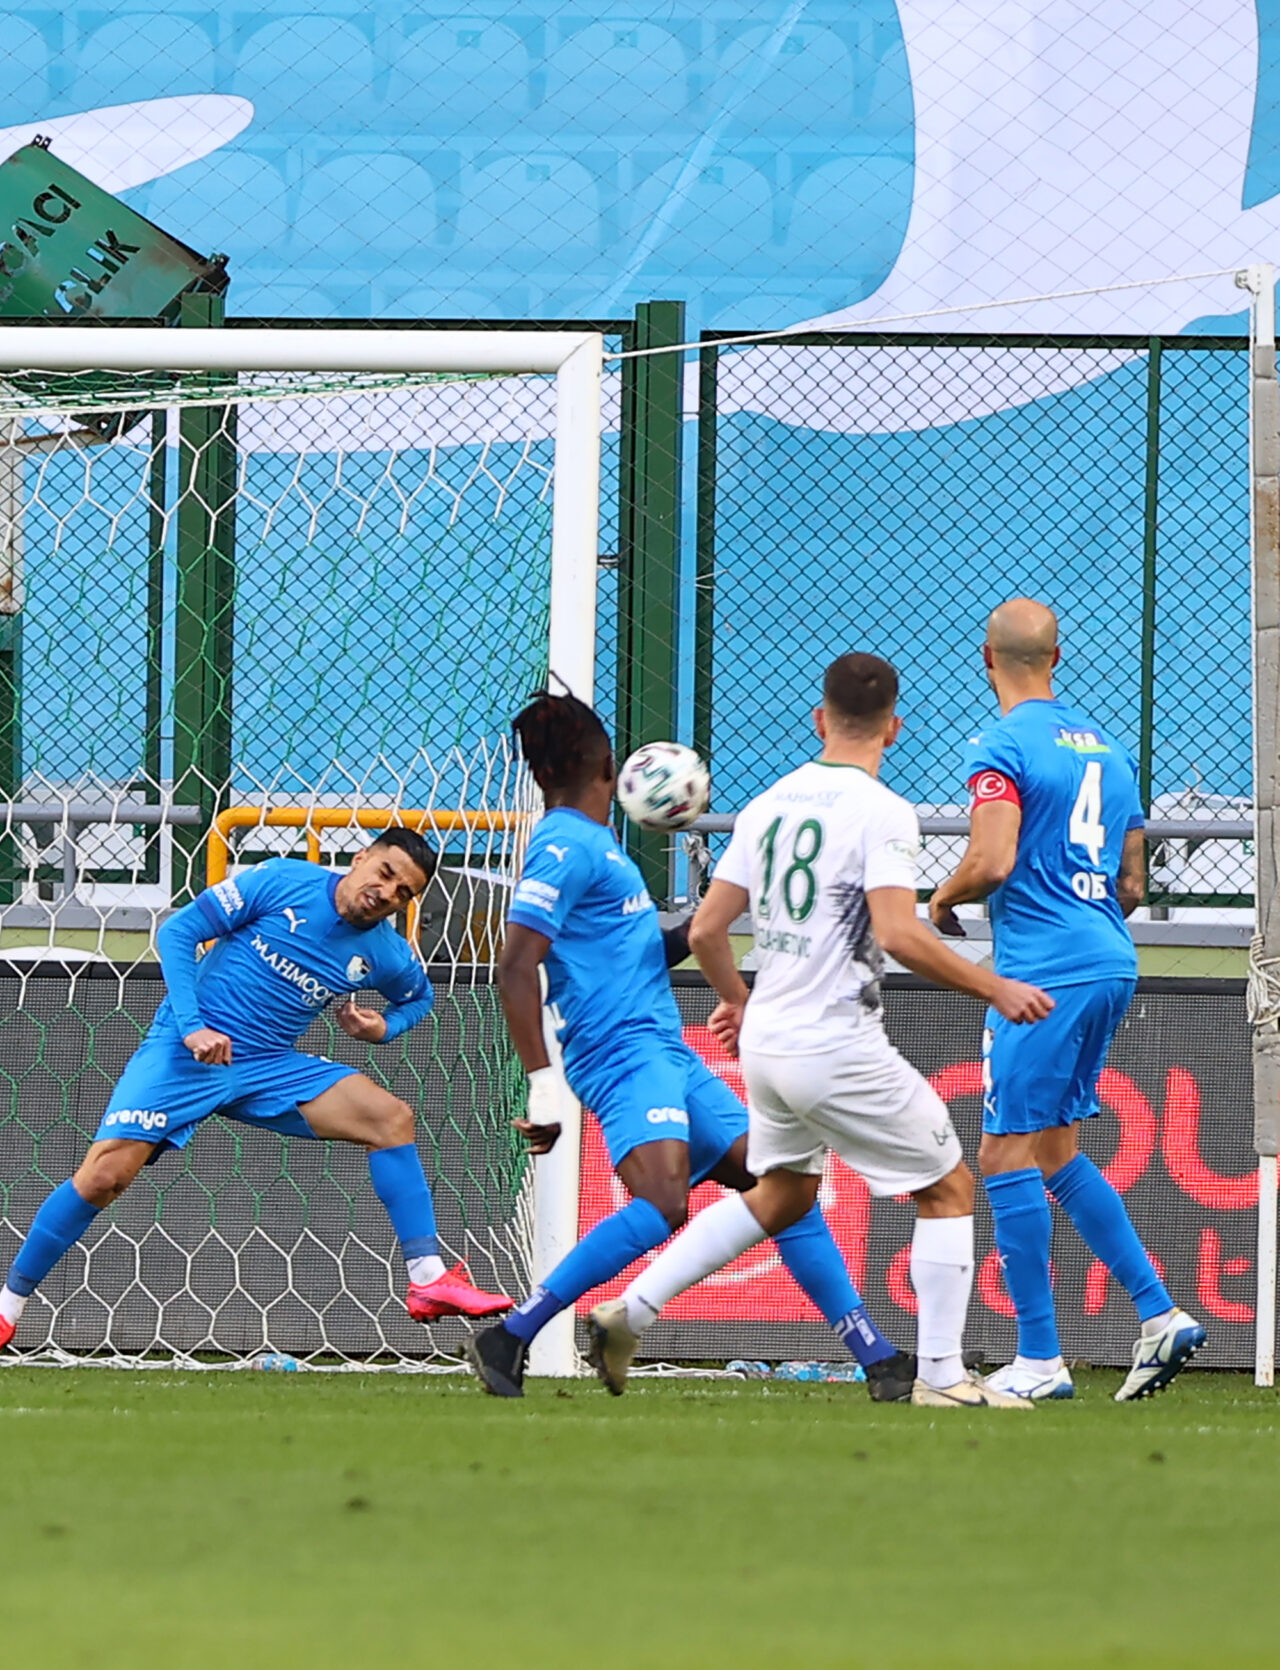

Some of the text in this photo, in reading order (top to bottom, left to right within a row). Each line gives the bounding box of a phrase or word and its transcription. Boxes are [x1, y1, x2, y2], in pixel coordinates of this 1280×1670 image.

[1069, 761, 1107, 866] 4
[756, 814, 825, 924] 18
[105, 1109, 168, 1131] arenya
